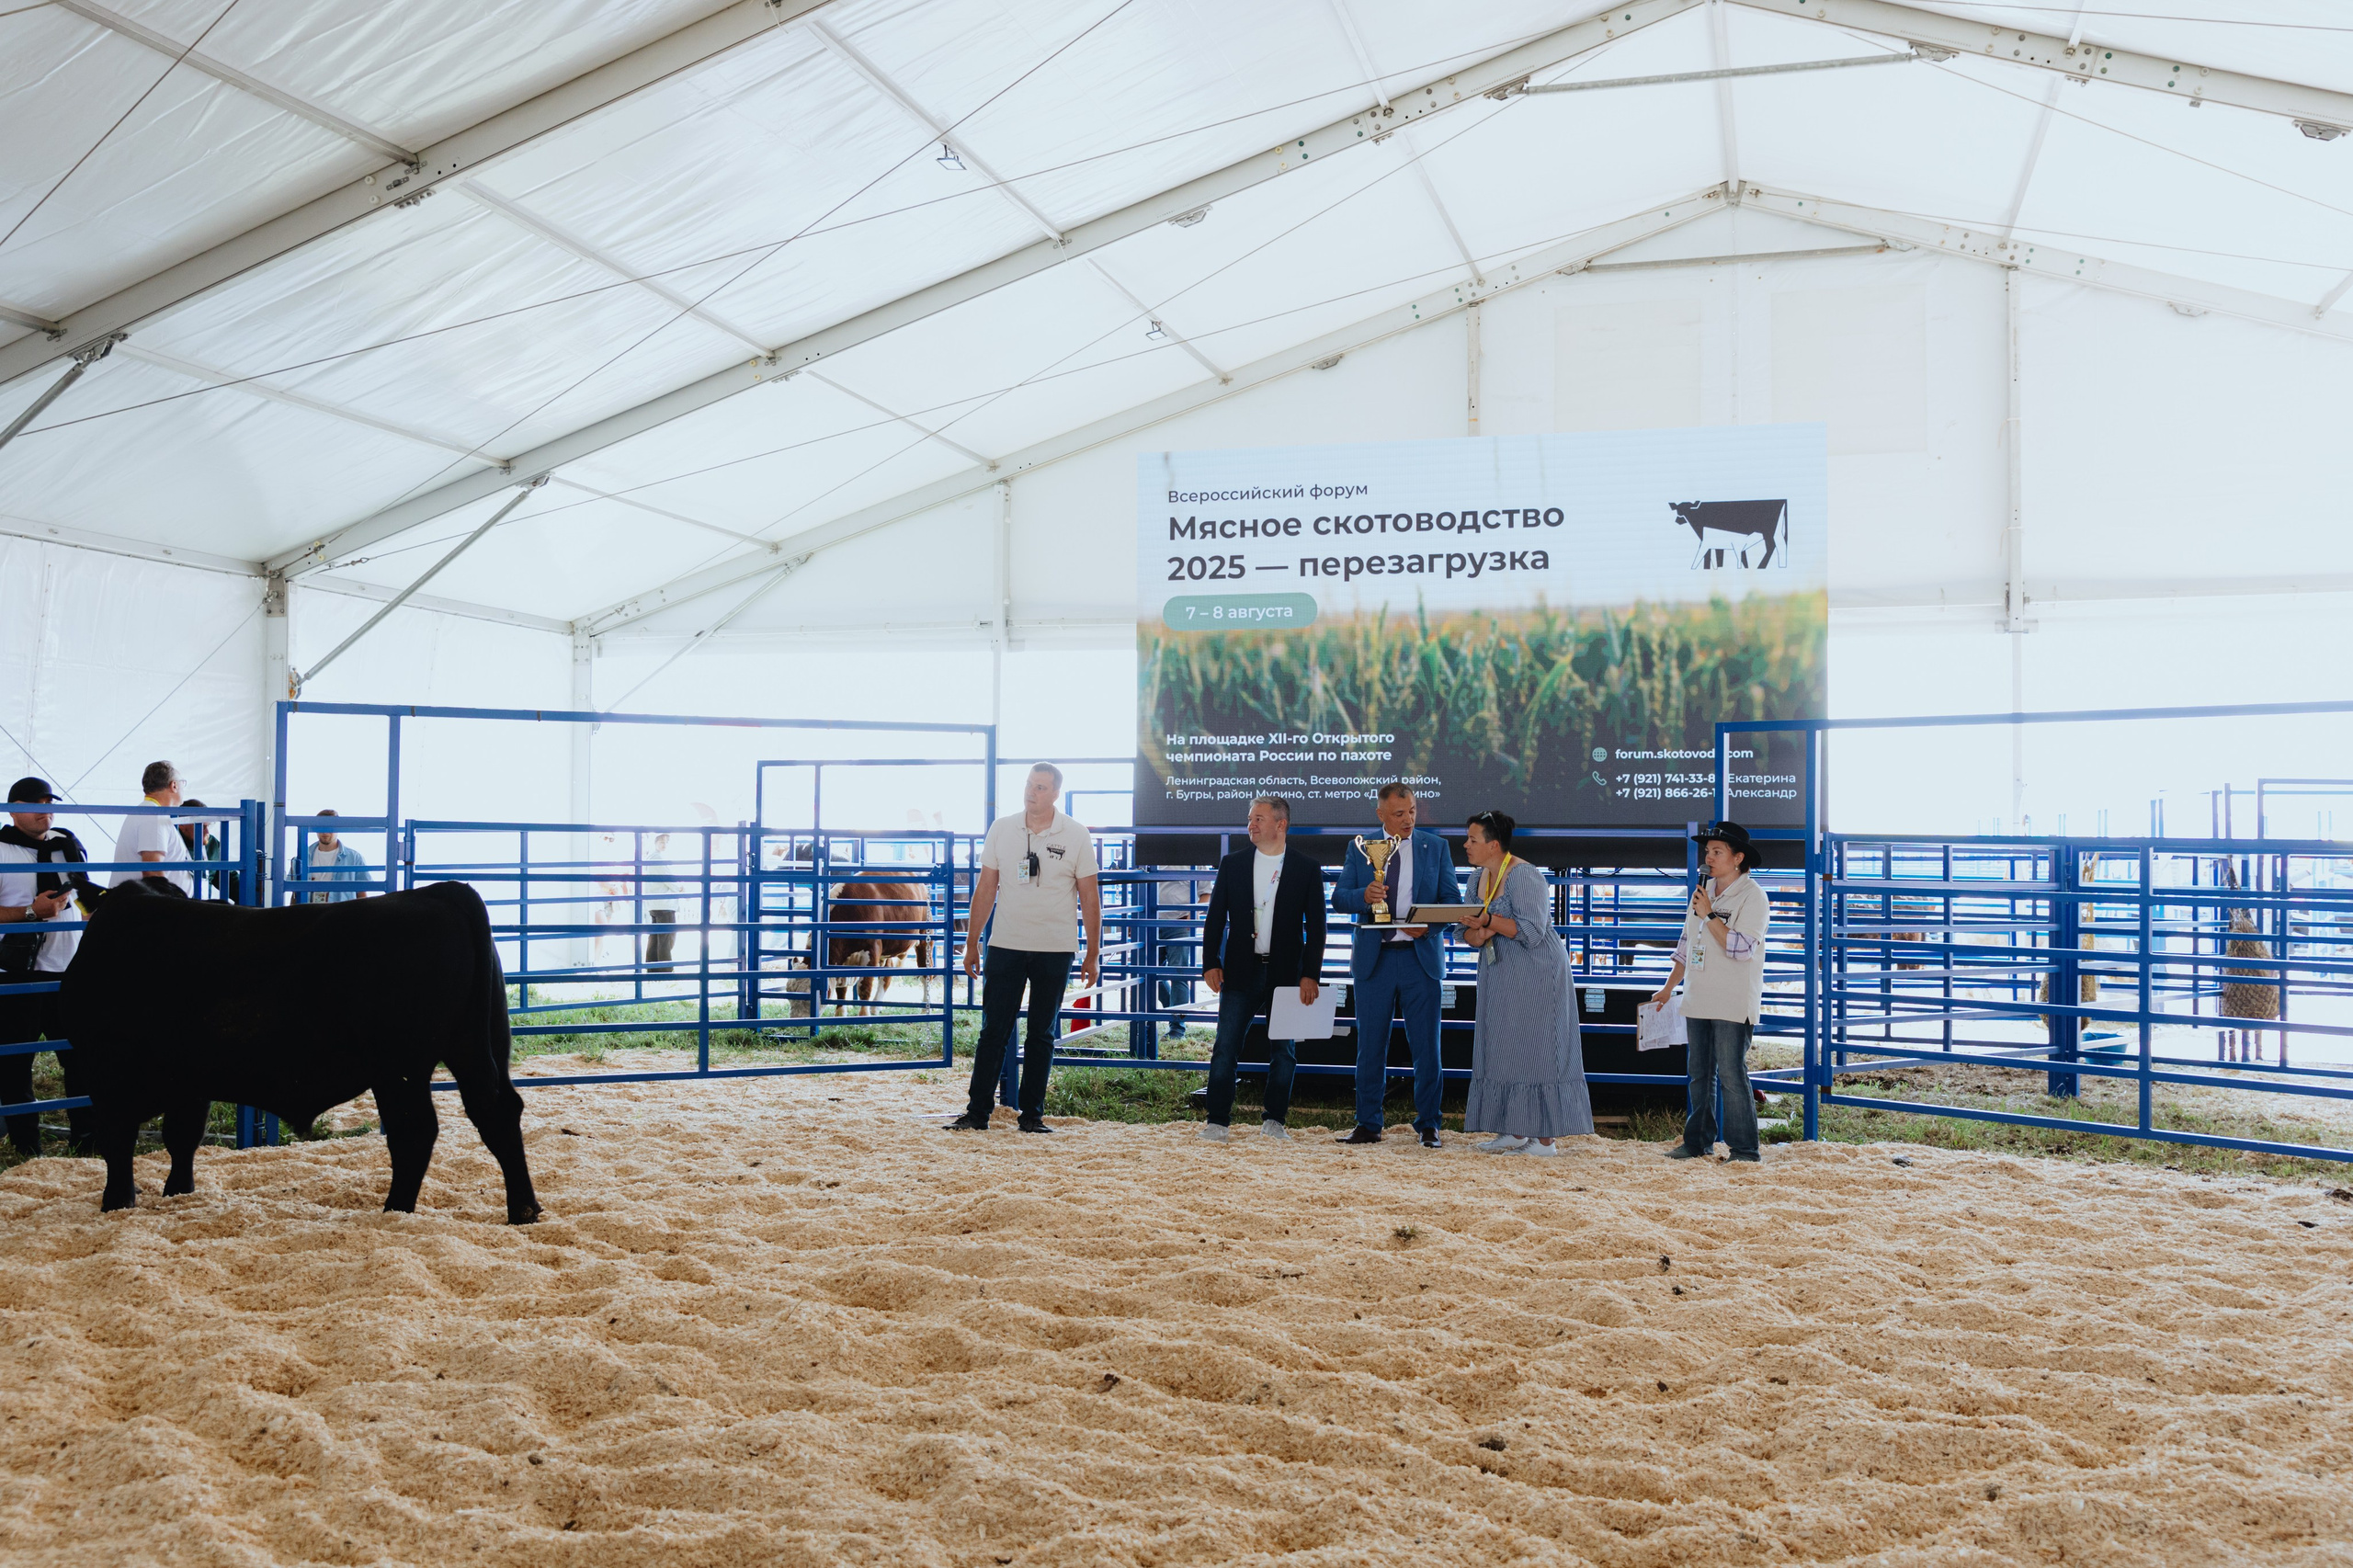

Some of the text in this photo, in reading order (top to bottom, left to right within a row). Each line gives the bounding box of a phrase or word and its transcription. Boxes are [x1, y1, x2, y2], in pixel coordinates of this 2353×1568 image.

[1167, 483, 1369, 504] Всероссийский форум
[1169, 506, 1564, 540] Мясное скотоводство
[1168, 555, 1245, 580] 2025
[1300, 549, 1550, 582] перезагрузка
[1187, 607, 1195, 619] 7
[1213, 606, 1222, 619] 8
[1228, 605, 1293, 622] августа
[1166, 733, 1394, 747] На площадке XII-го Открытого
[1165, 750, 1392, 763] чемпионата России по пахоте
[1165, 775, 1440, 787] Ленинградская область, Всеволожский район,
[1616, 773, 1796, 786] +7 (921) 741-33-8 Екатерина
[1176, 790, 1213, 801] Бугры,
[1217, 790, 1253, 801] район
[1325, 791, 1360, 800] метро
[1616, 788, 1798, 800] +7 (921) 866-26-1 Александр
